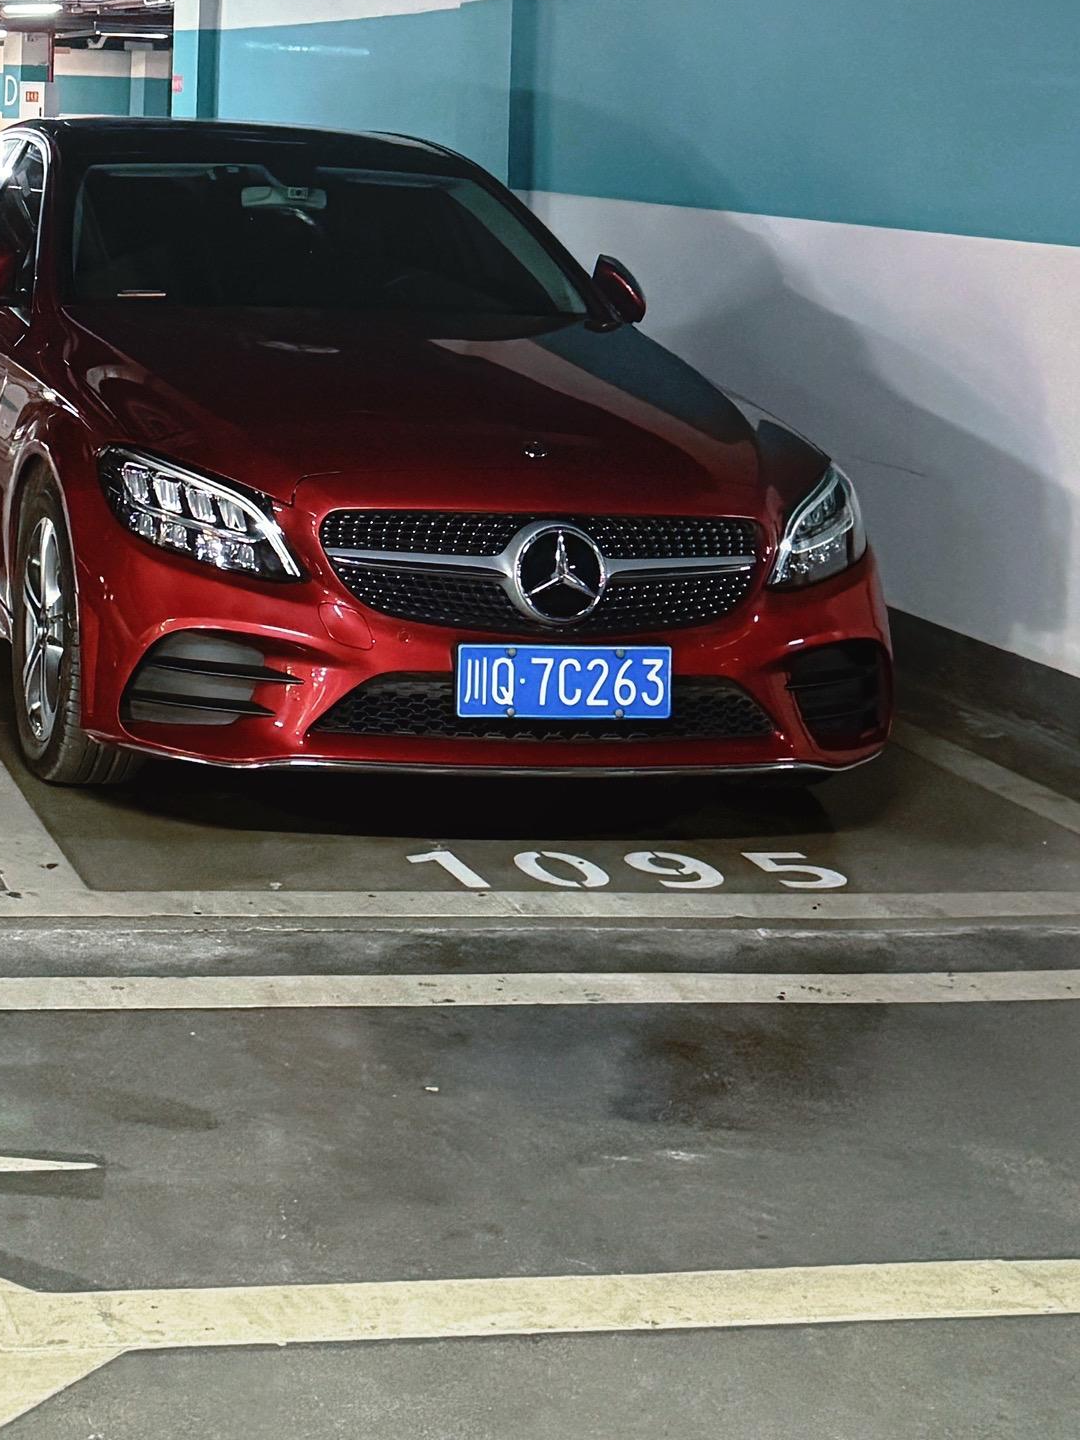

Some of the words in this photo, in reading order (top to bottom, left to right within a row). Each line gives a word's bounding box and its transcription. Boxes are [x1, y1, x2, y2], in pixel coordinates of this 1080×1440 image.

[4, 75, 18, 106] D
[464, 656, 665, 707] 川Q·7C263
[405, 850, 848, 889] 1095
